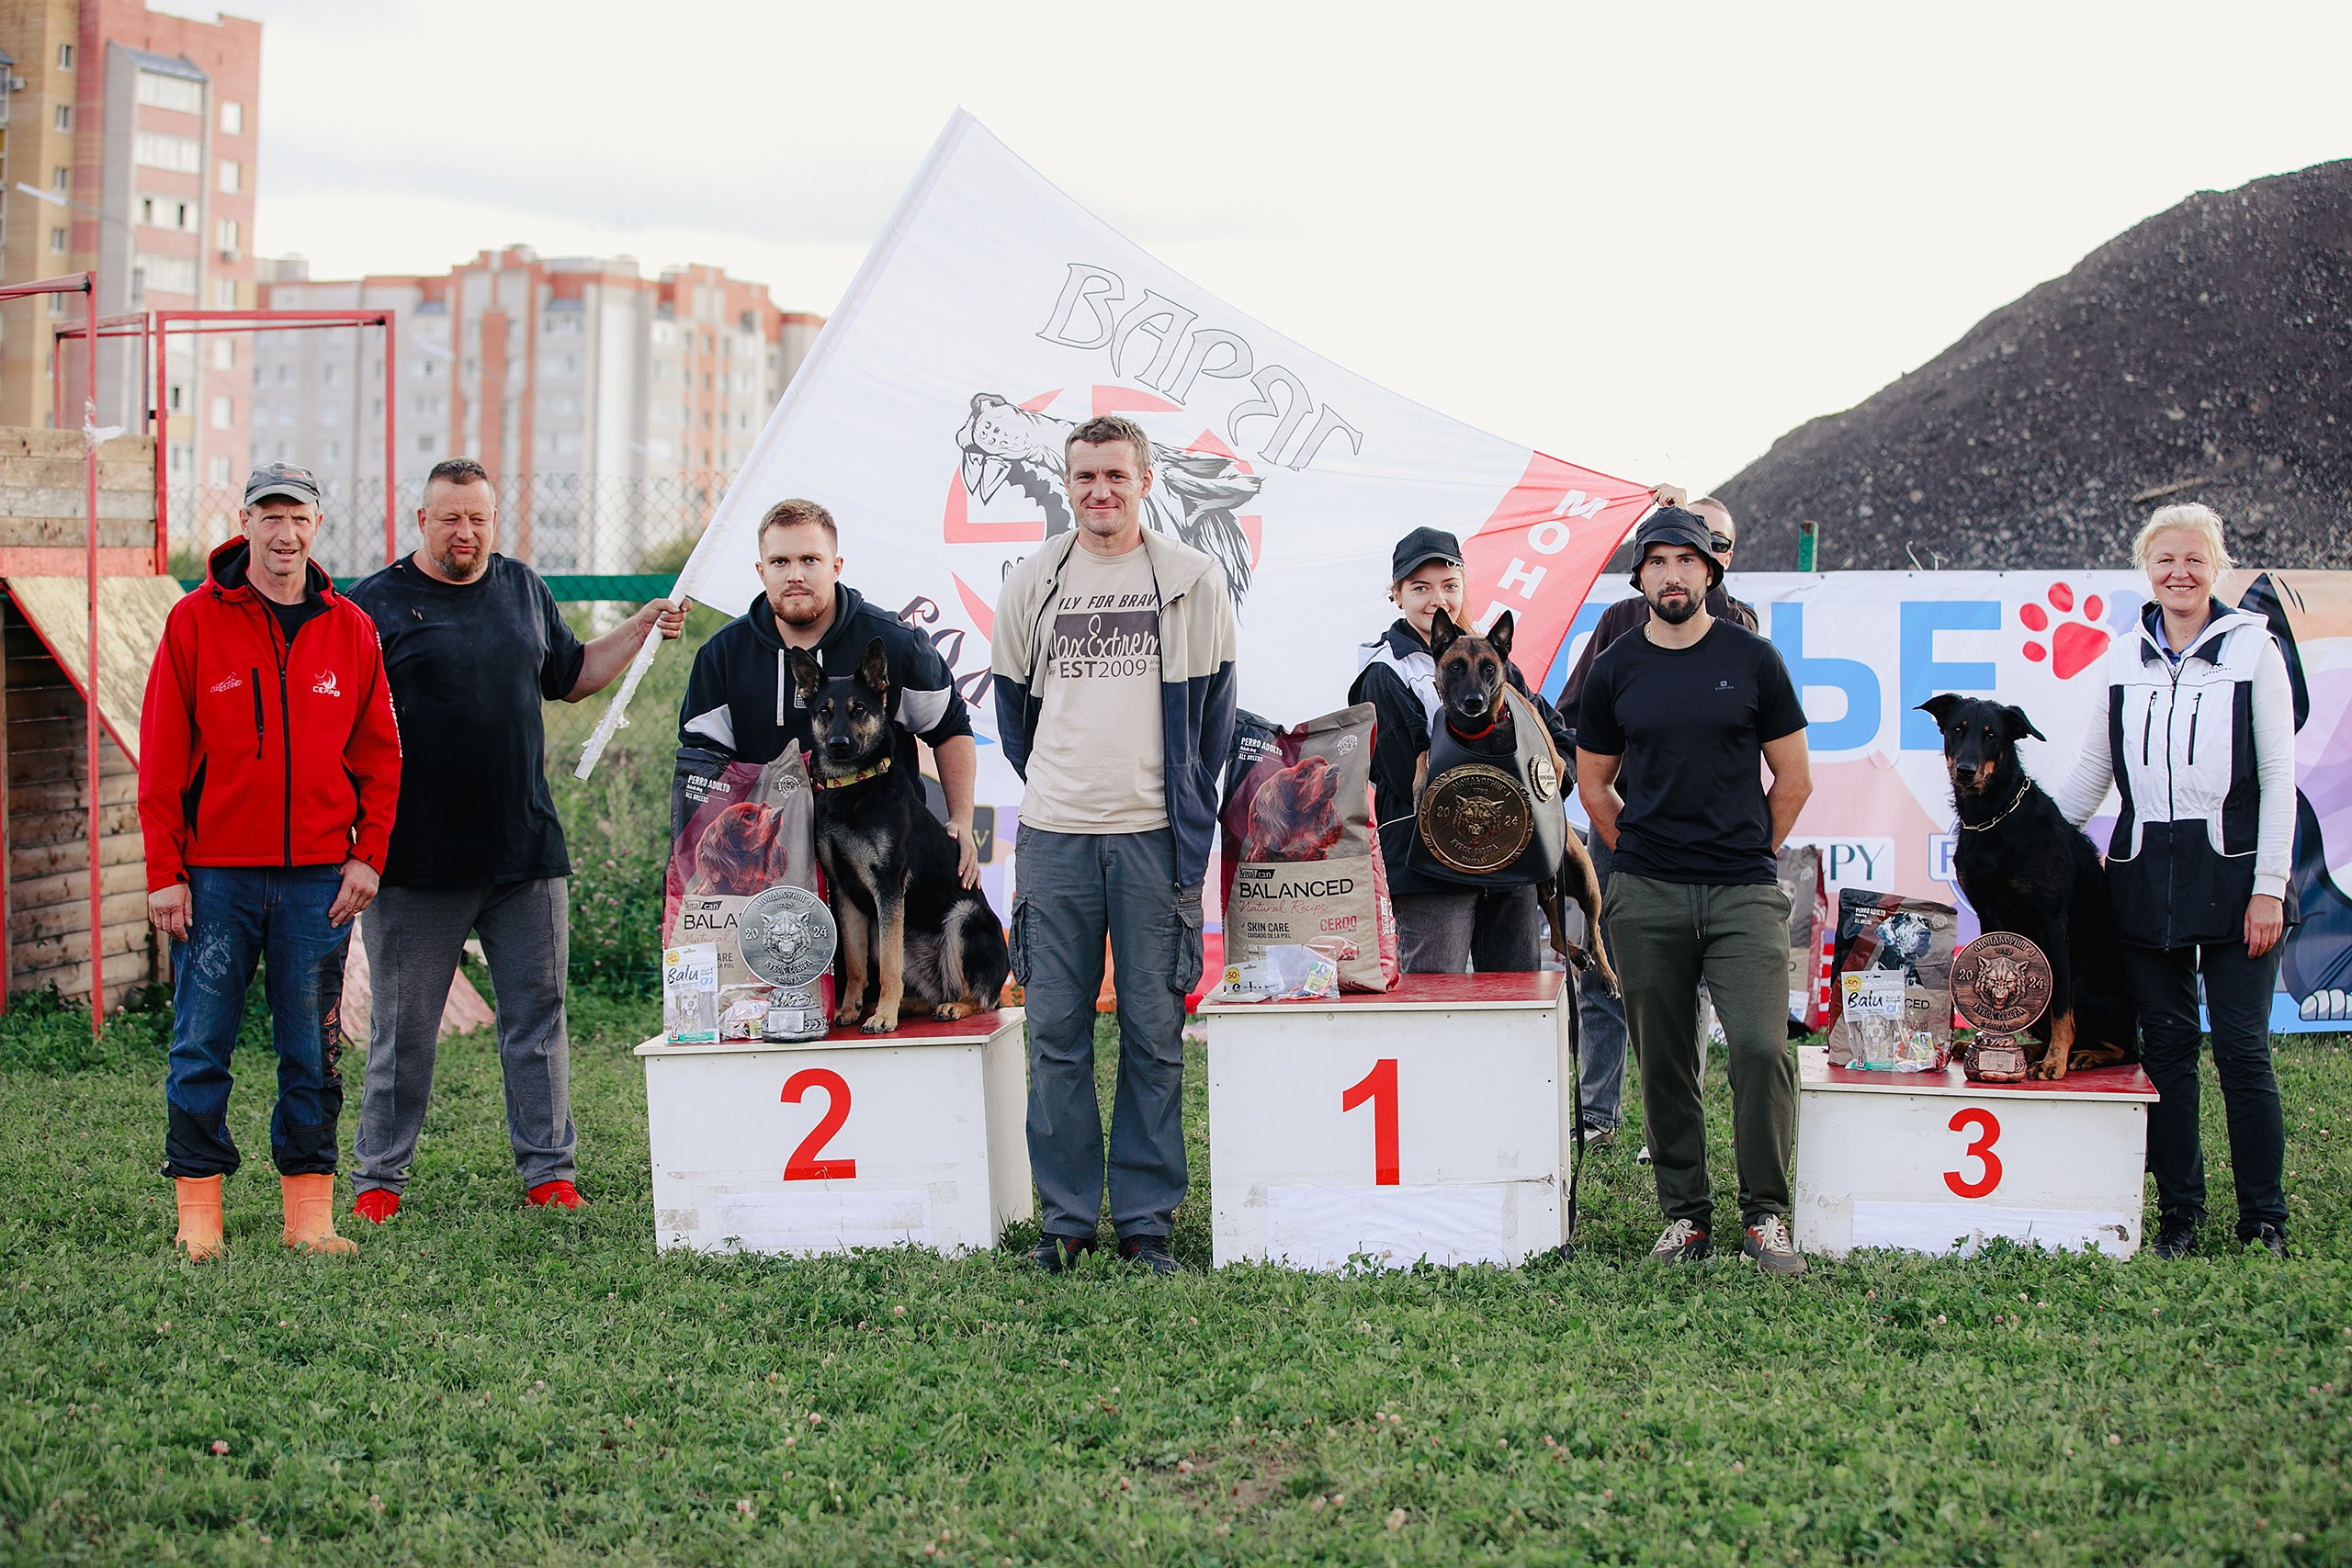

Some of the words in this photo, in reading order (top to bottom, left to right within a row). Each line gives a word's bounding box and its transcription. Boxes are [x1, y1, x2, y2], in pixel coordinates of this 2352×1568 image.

[1472, 489, 1611, 637] МОНД
[1058, 596, 1082, 610] LY
[1087, 594, 1114, 609] FOR
[1118, 593, 1157, 607] BRAV
[1769, 600, 2003, 751] ЬЕ
[1240, 737, 1261, 748] PERRO
[1261, 741, 1283, 757] ADULTO
[687, 774, 707, 788] PERRO
[707, 779, 731, 794] ADULTO
[1436, 806, 1451, 818] 20
[1504, 815, 1519, 828] 24
[1829, 843, 1885, 882] PY
[1239, 878, 1354, 899] BALANCED
[1239, 899, 1286, 914] Natural
[1290, 899, 1329, 916] Recipe
[684, 912, 742, 931] BALA
[1247, 921, 1266, 932] SKIN
[1268, 922, 1290, 932] CARE
[1319, 915, 1358, 931] CERDO
[683, 930, 732, 944] Natural
[745, 927, 759, 940] 20
[812, 925, 828, 938] 24
[717, 953, 733, 962] ARE
[668, 964, 698, 985] Balu
[1958, 968, 1973, 981] 20
[2028, 976, 2044, 989] 24
[1848, 990, 1883, 1009] Balu
[1904, 998, 1930, 1010] CED
[780, 1067, 857, 1182] 2
[1342, 1058, 1400, 1186] 1
[1942, 1107, 2003, 1199] 3
